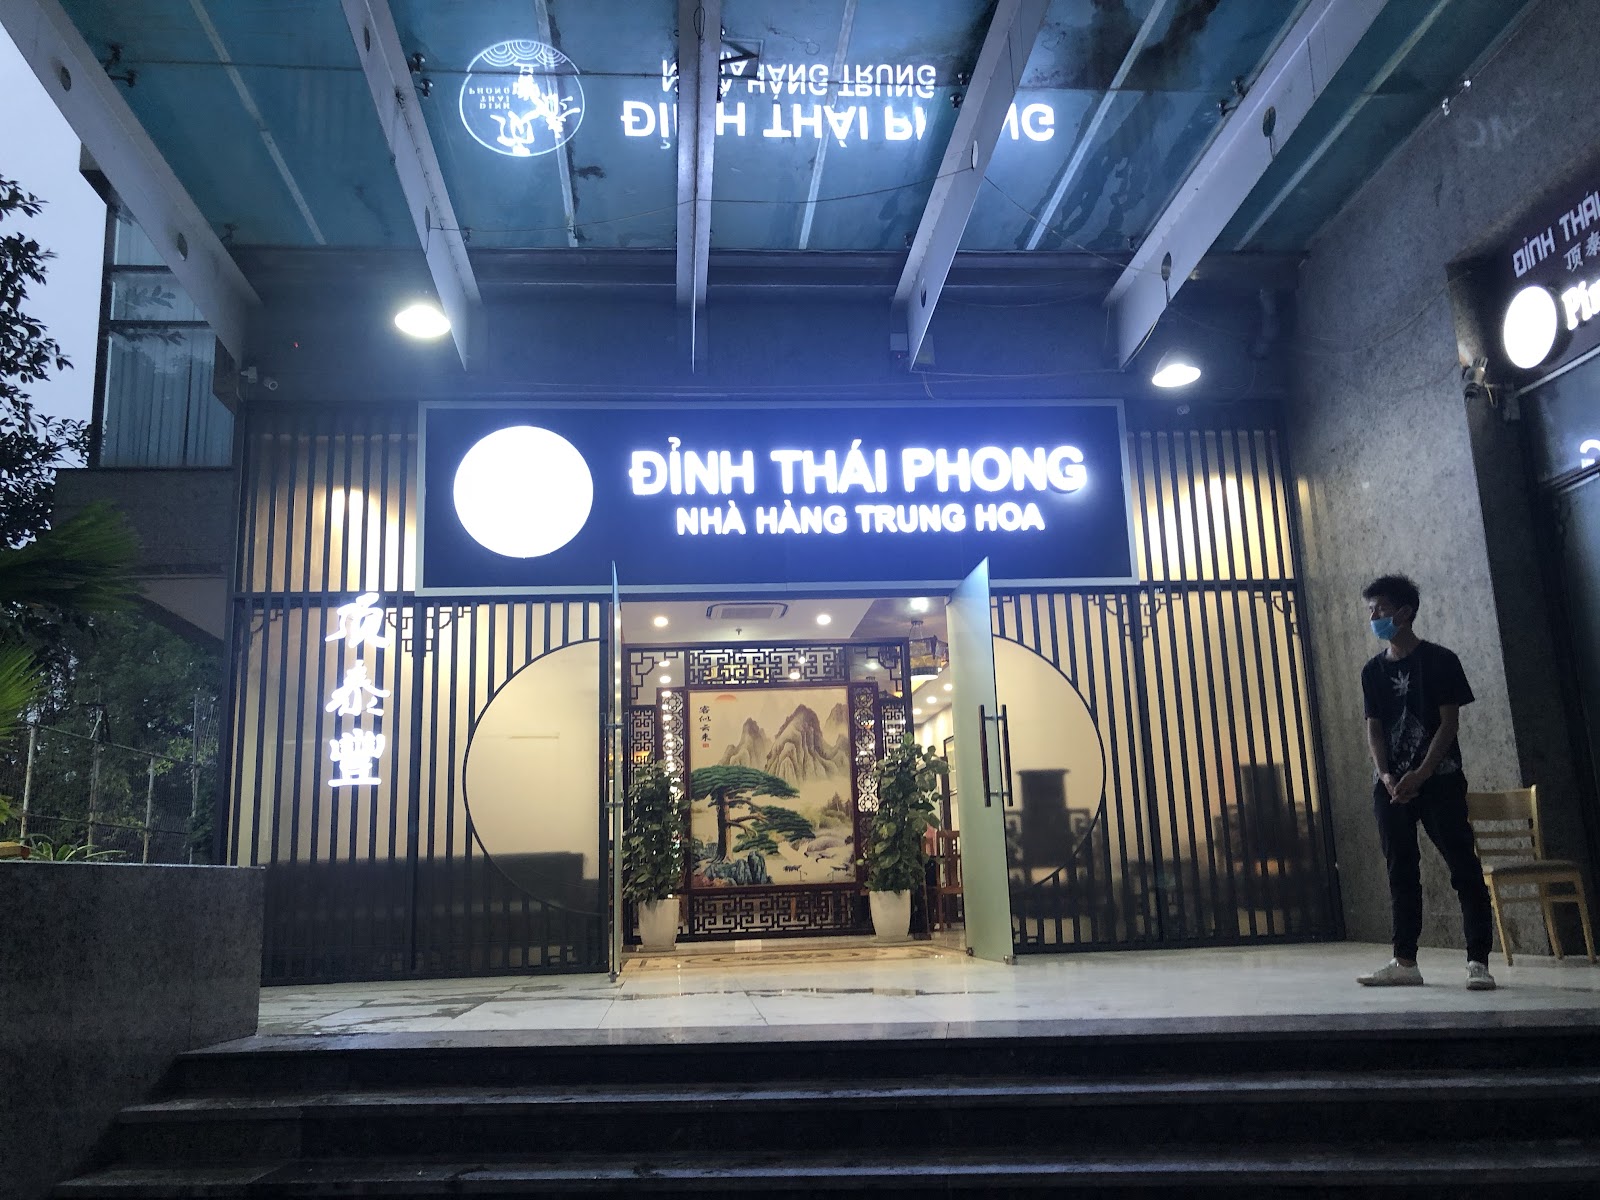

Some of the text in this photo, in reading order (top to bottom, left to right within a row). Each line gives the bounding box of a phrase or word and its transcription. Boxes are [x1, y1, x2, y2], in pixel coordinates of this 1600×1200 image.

[629, 436, 1088, 496] ĐỈNH THÁI PHONG
[676, 500, 1046, 535] NHÀ HÀNG TRUNG HOA
